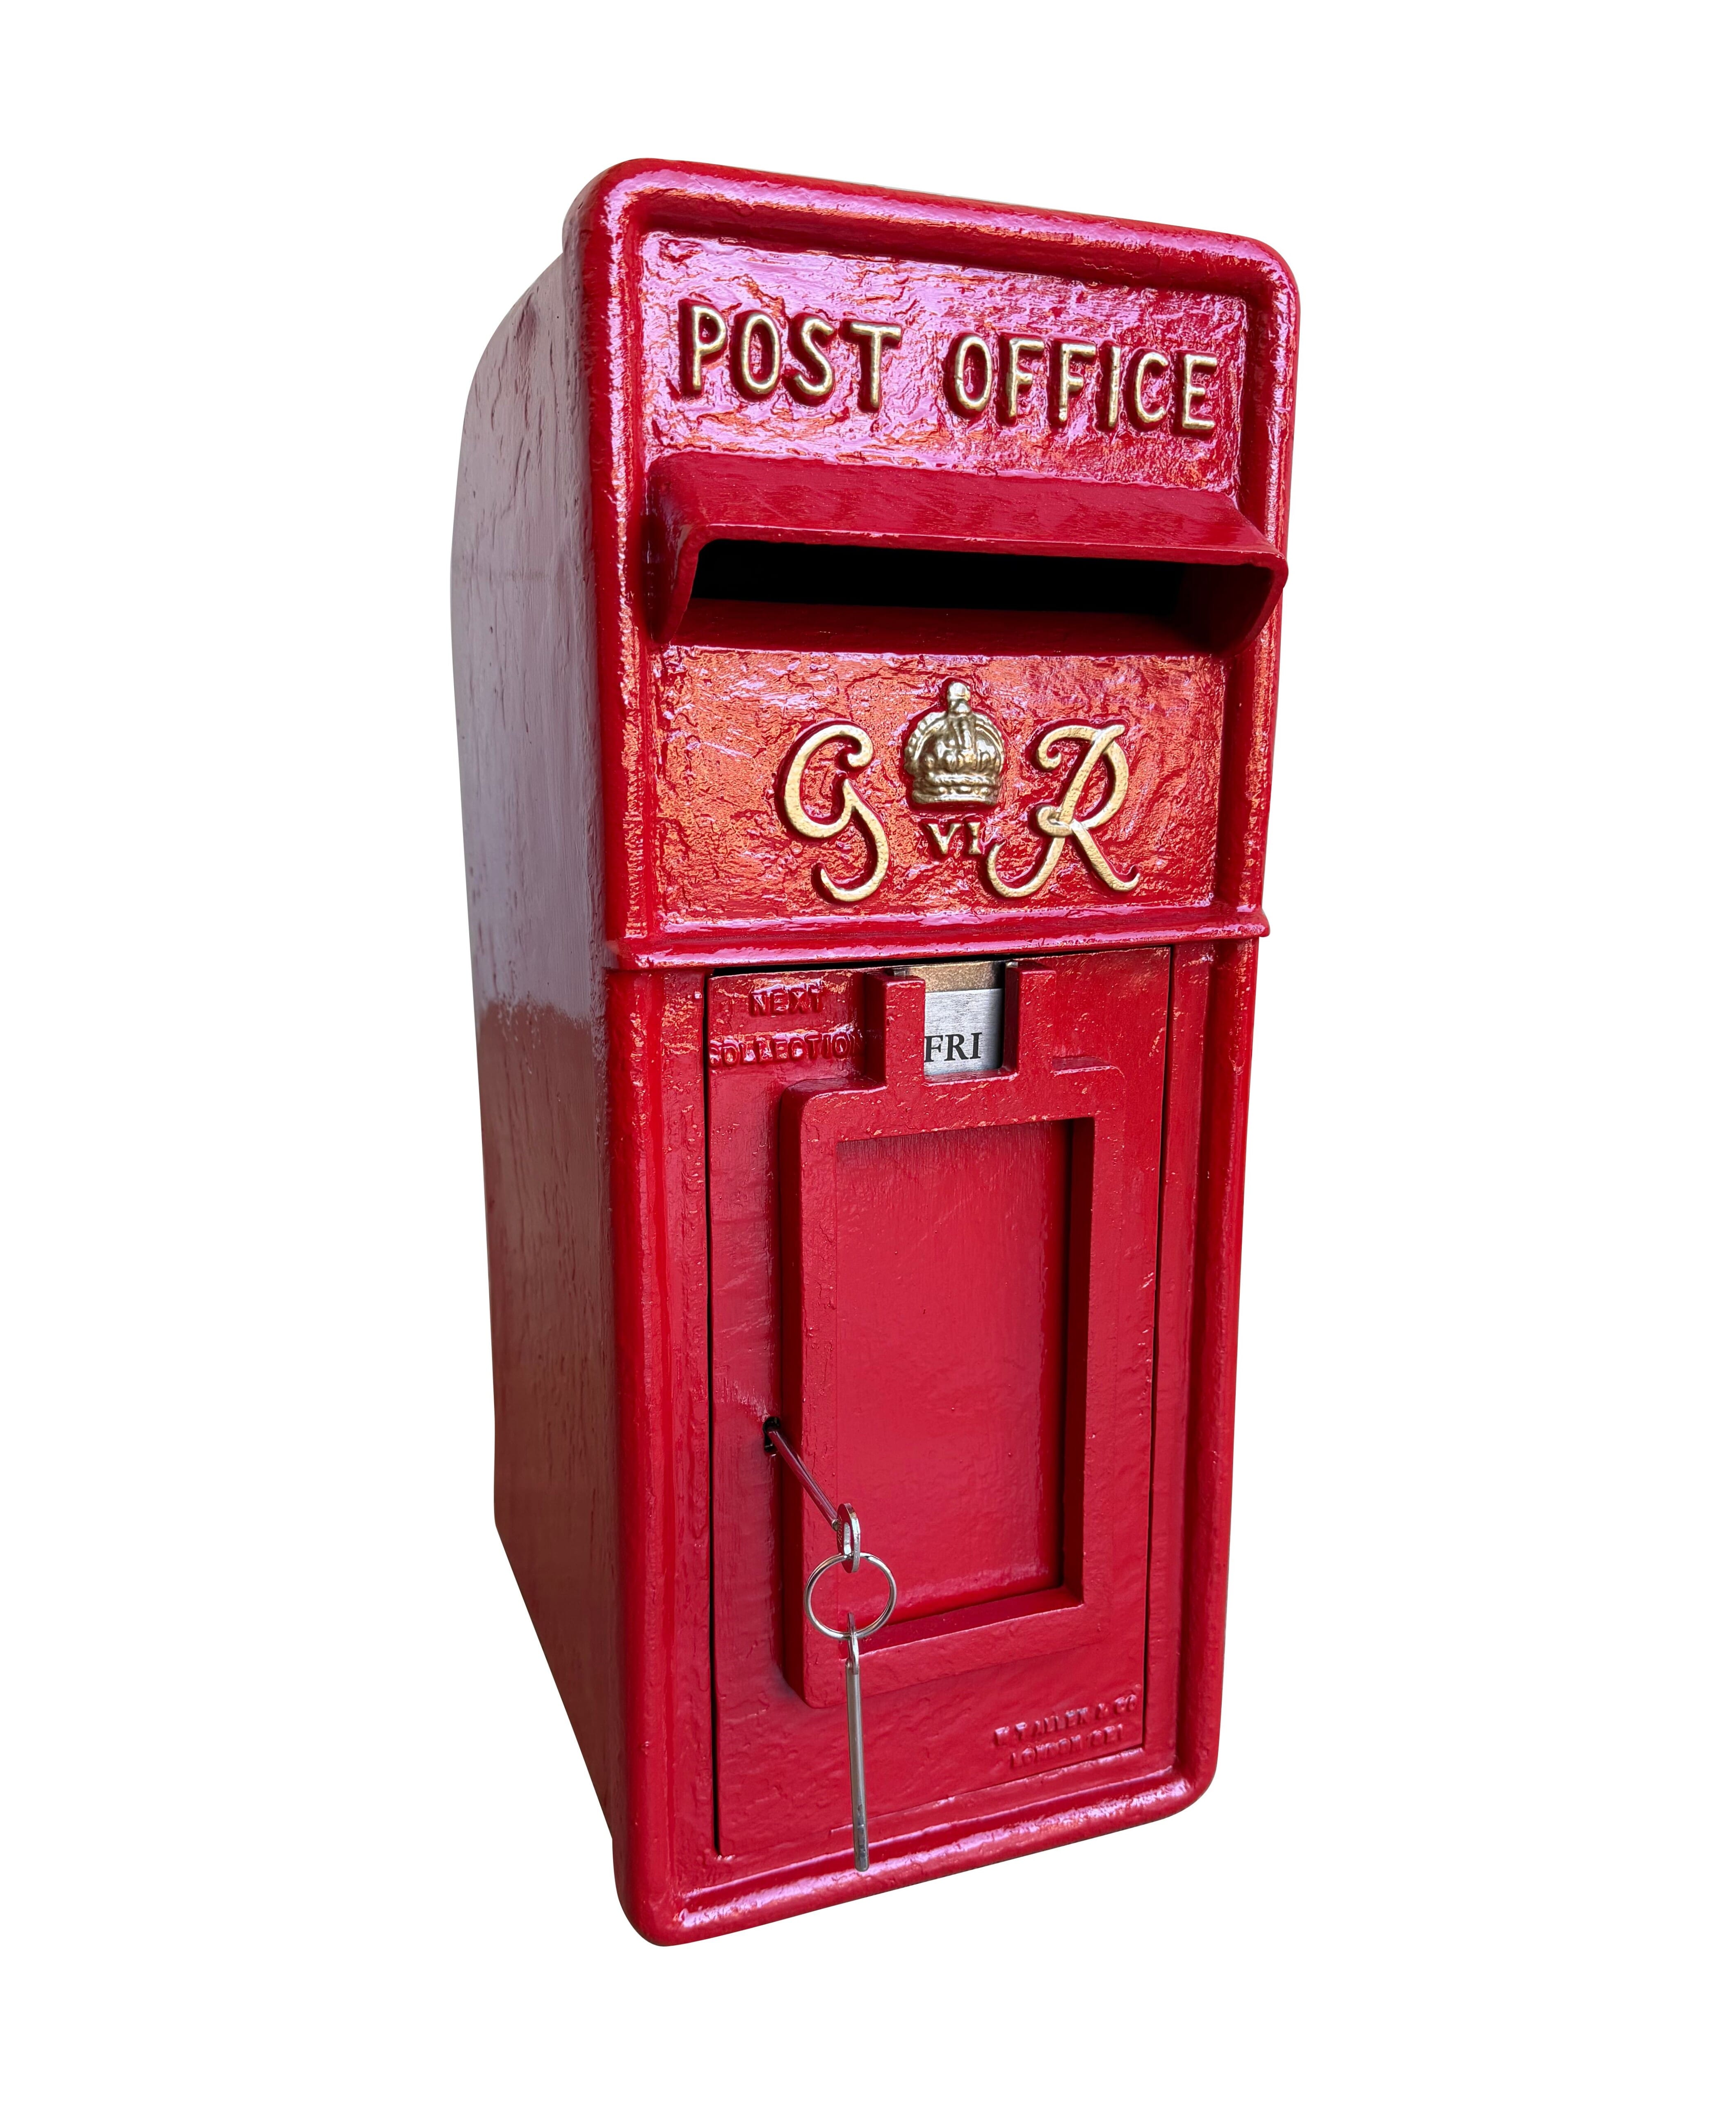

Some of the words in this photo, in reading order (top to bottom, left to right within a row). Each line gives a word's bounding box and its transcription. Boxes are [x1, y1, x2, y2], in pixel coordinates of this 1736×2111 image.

[692, 304, 902, 410] POST
[952, 333, 1219, 431] OFFICE
[784, 724, 890, 902] G
[987, 724, 1141, 898] R
[928, 822, 983, 855] VI
[748, 982, 824, 1016] NEXT
[924, 1032, 983, 1063] FRI
